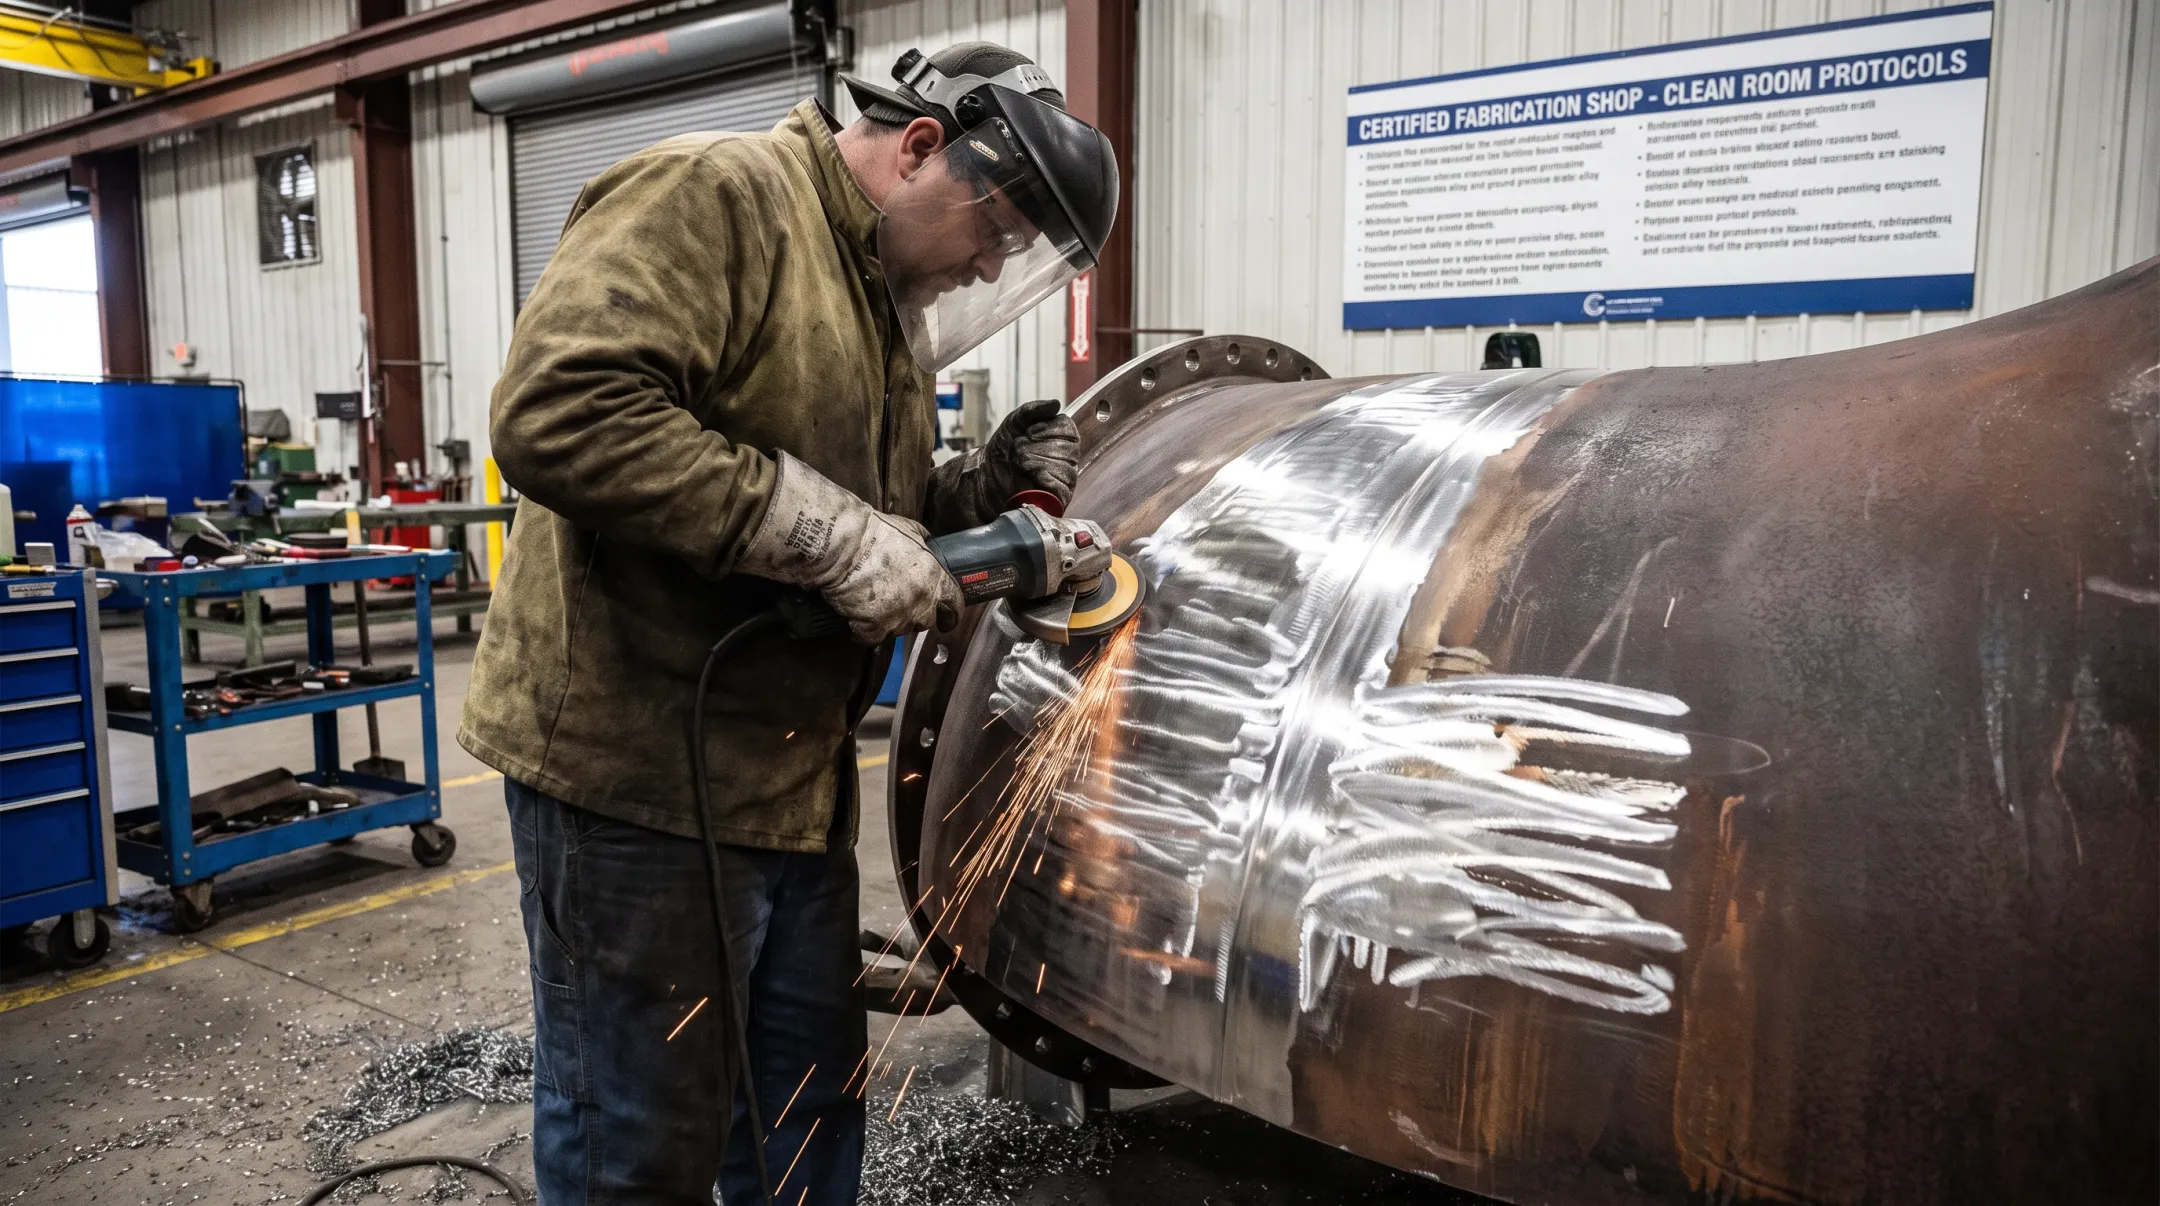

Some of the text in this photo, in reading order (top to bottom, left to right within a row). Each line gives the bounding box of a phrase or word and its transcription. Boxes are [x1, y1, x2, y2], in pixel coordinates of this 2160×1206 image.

[1359, 110, 1450, 141] CERTIFIED
[1454, 94, 1581, 130] FABRICATION
[1586, 86, 1643, 115] SHOP
[1663, 76, 1735, 107] CLEAN
[1741, 67, 1812, 97] ROOM
[1818, 48, 1967, 89] PROTOCOLS
